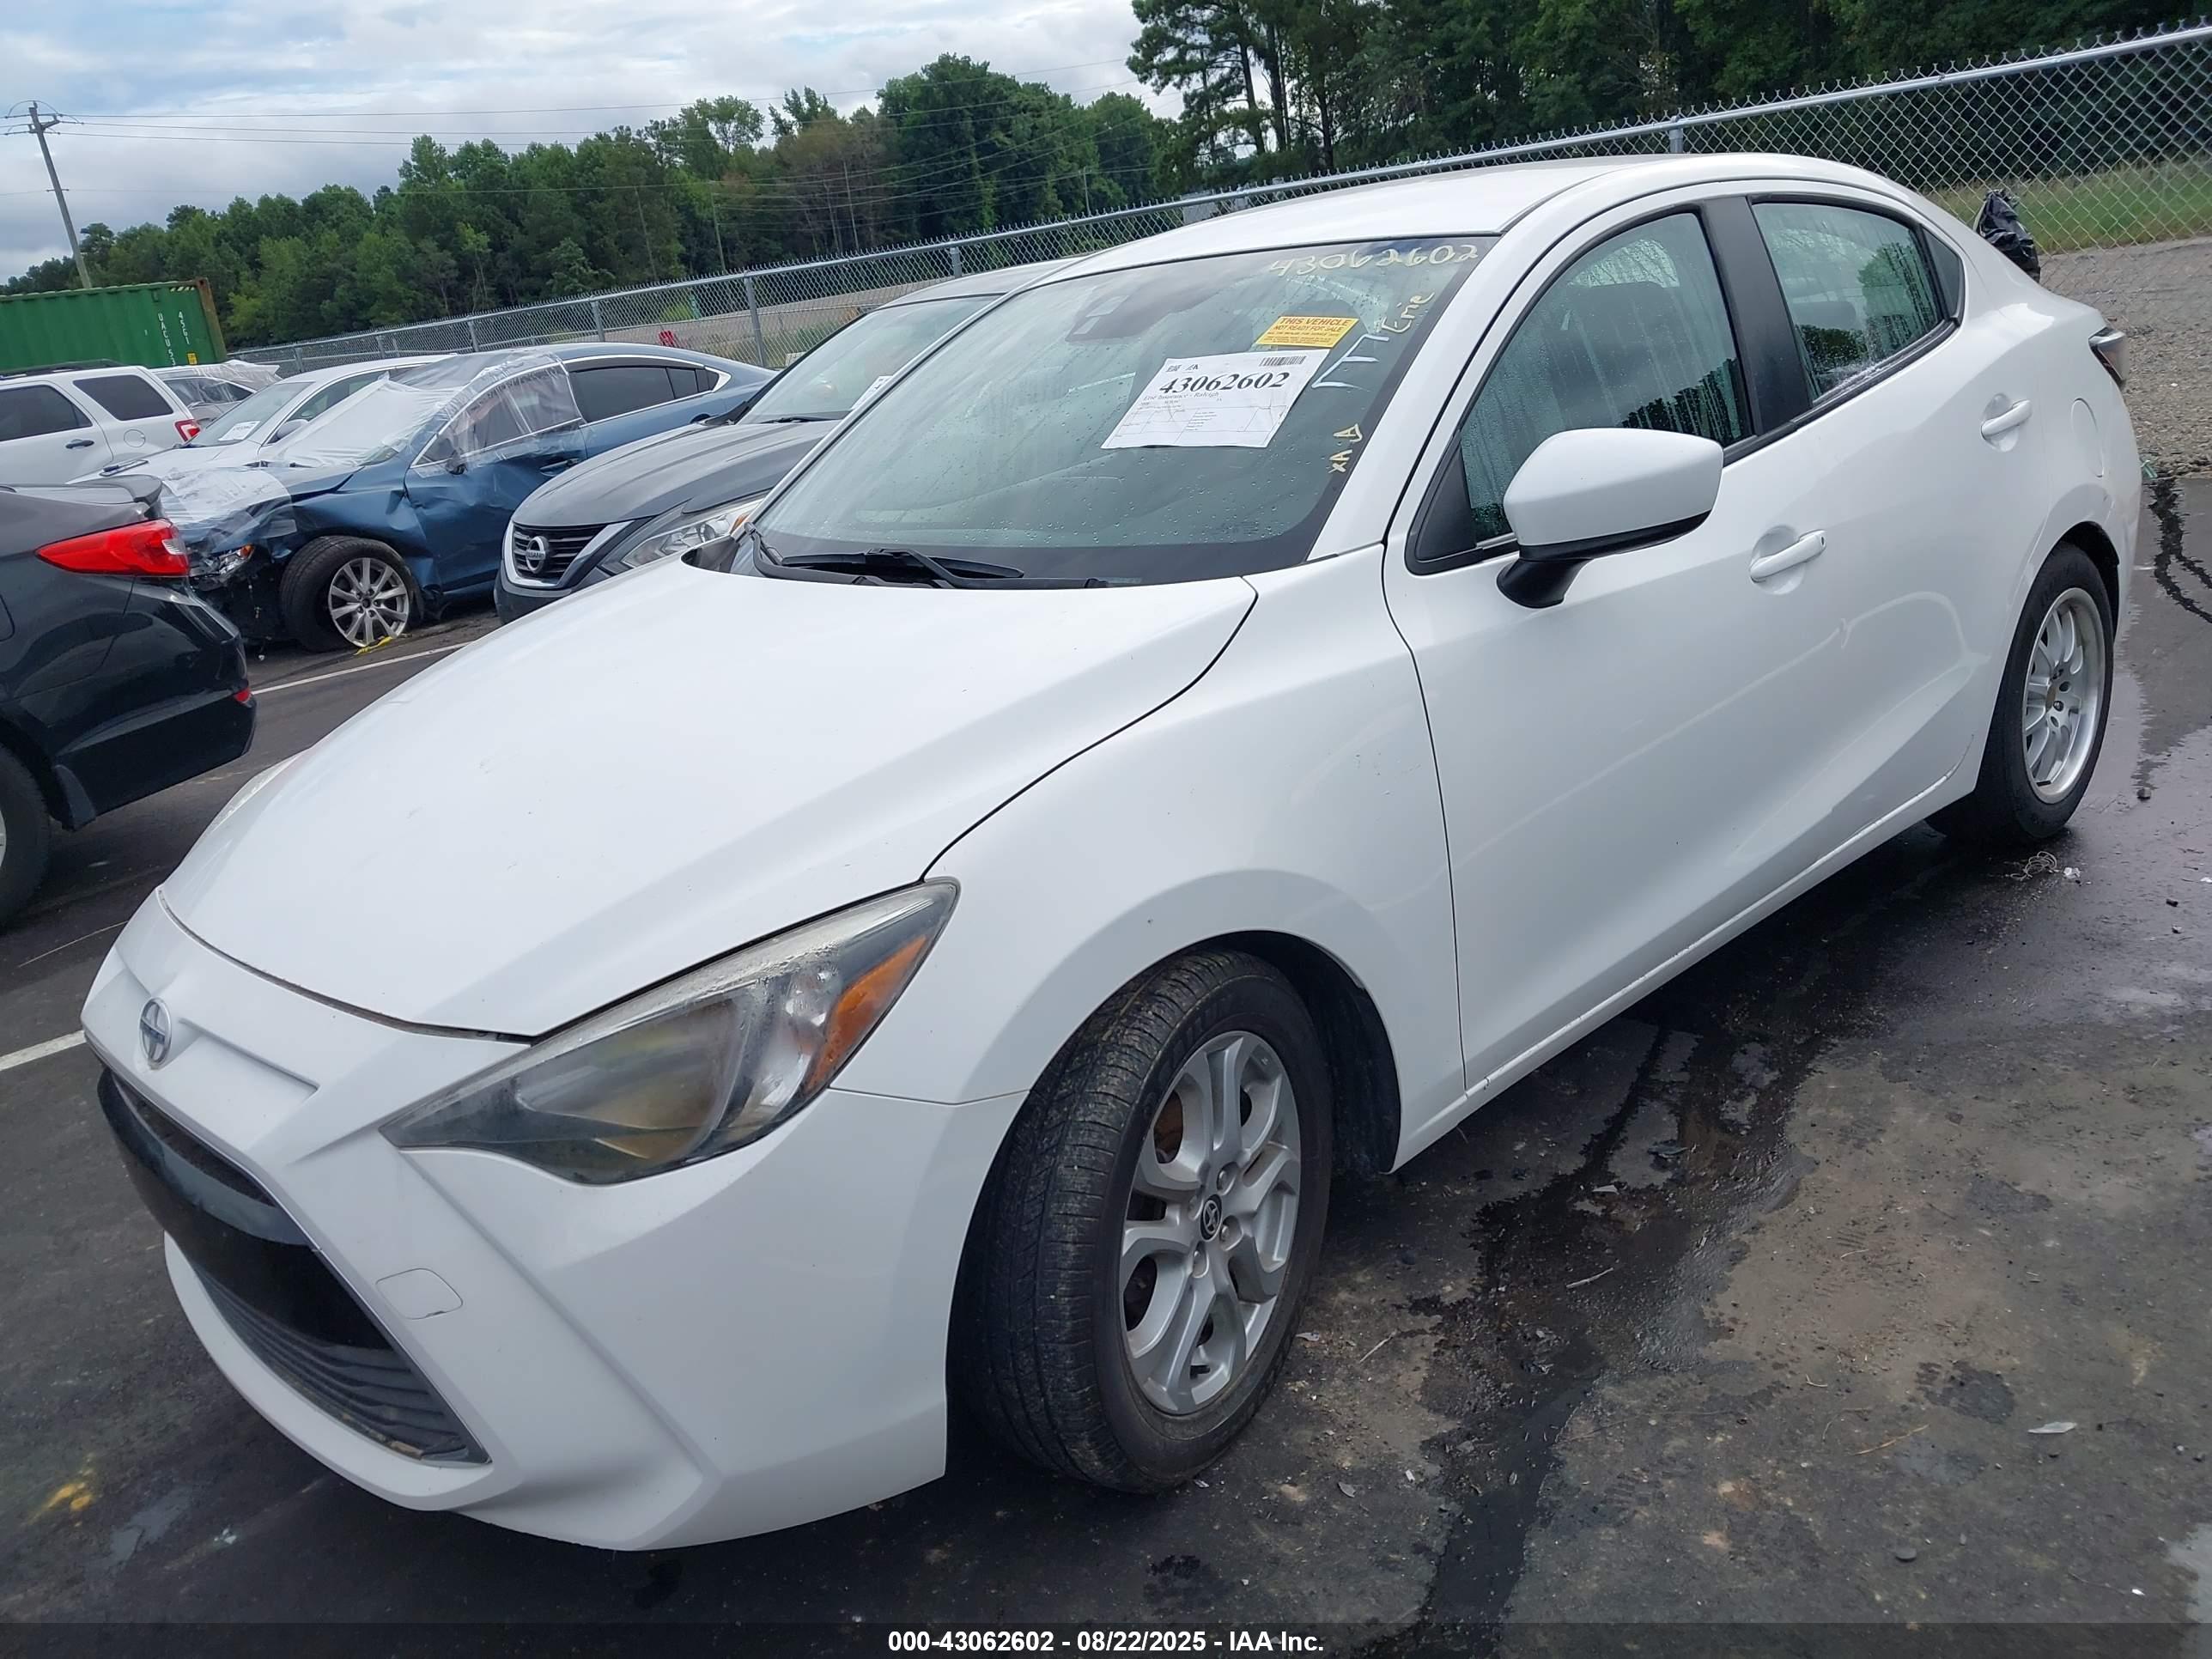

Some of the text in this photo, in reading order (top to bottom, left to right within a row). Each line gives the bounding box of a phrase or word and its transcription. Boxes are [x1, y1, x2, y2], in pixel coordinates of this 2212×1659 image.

[1268, 245, 1479, 277] 43062602
[178, 311, 190, 344] 45G1
[1305, 318, 1352, 326] VEHICLE
[1159, 372, 1290, 393] 43062602
